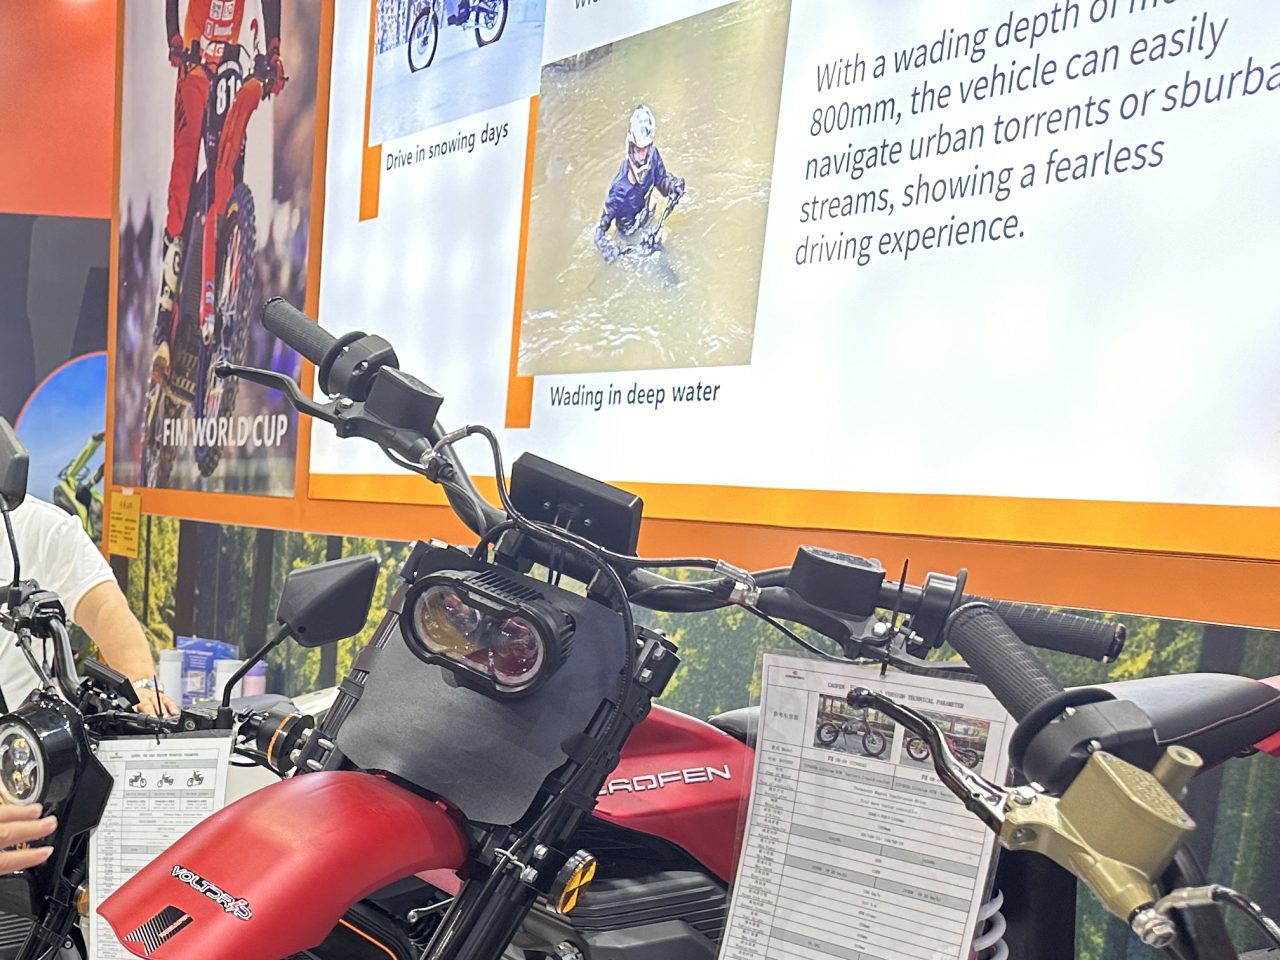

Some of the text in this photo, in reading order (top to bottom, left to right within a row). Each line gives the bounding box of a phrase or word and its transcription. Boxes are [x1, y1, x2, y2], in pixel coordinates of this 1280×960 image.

[817, 53, 866, 92] With
[873, 55, 886, 79] a
[894, 28, 988, 73] wading
[995, 0, 1080, 49] depth
[810, 11, 1229, 137] 800mm, the vehicle can easily
[386, 120, 509, 171] Drive in snowing days
[805, 138, 903, 180] navigate
[909, 123, 985, 161] urban
[994, 96, 1111, 145] torrents
[1119, 88, 1156, 120] or
[799, 139, 1165, 224] streams, showing a fearless
[795, 213, 1025, 267] driving experience.
[550, 381, 721, 411] Wading in deep water
[162, 413, 289, 447] FIM WORLD CUP
[598, 764, 732, 796] AOFEN
